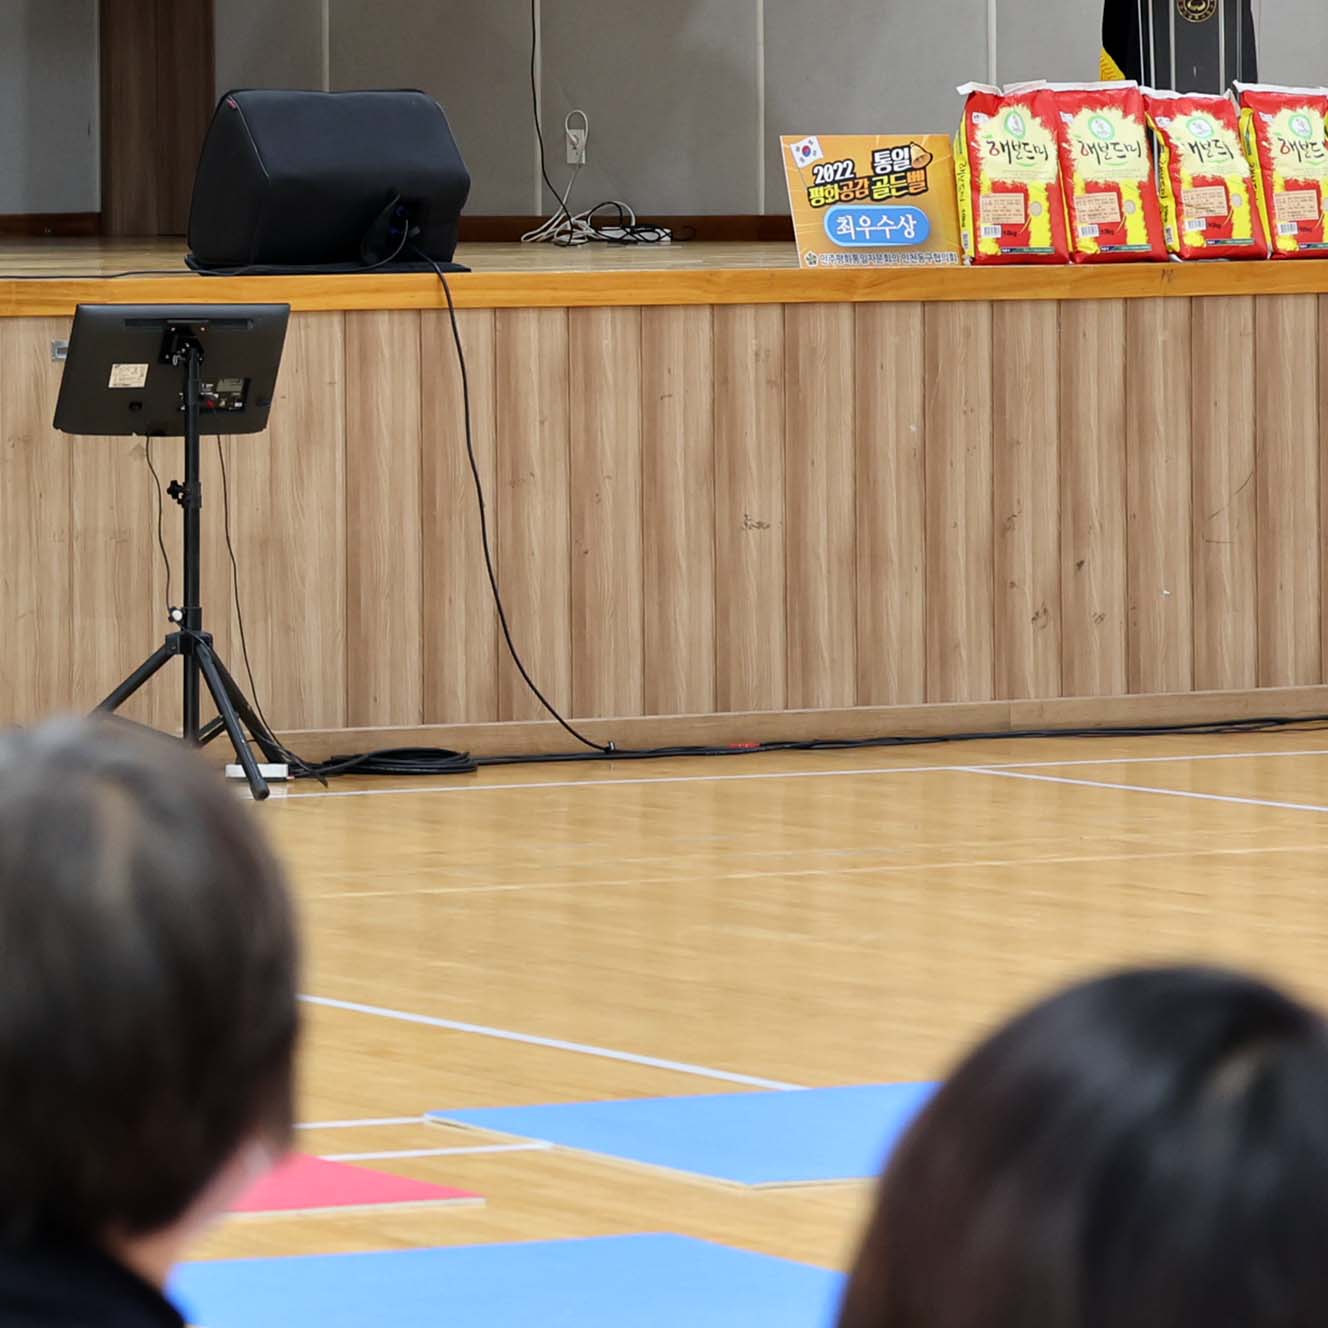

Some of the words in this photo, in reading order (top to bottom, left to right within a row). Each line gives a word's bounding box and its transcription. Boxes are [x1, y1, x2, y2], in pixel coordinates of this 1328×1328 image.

[813, 160, 855, 184] 2022
[873, 147, 912, 175] 통일
[809, 178, 870, 207] 평화공감
[871, 170, 928, 200] 골든벨
[836, 214, 917, 240] 최우수상
